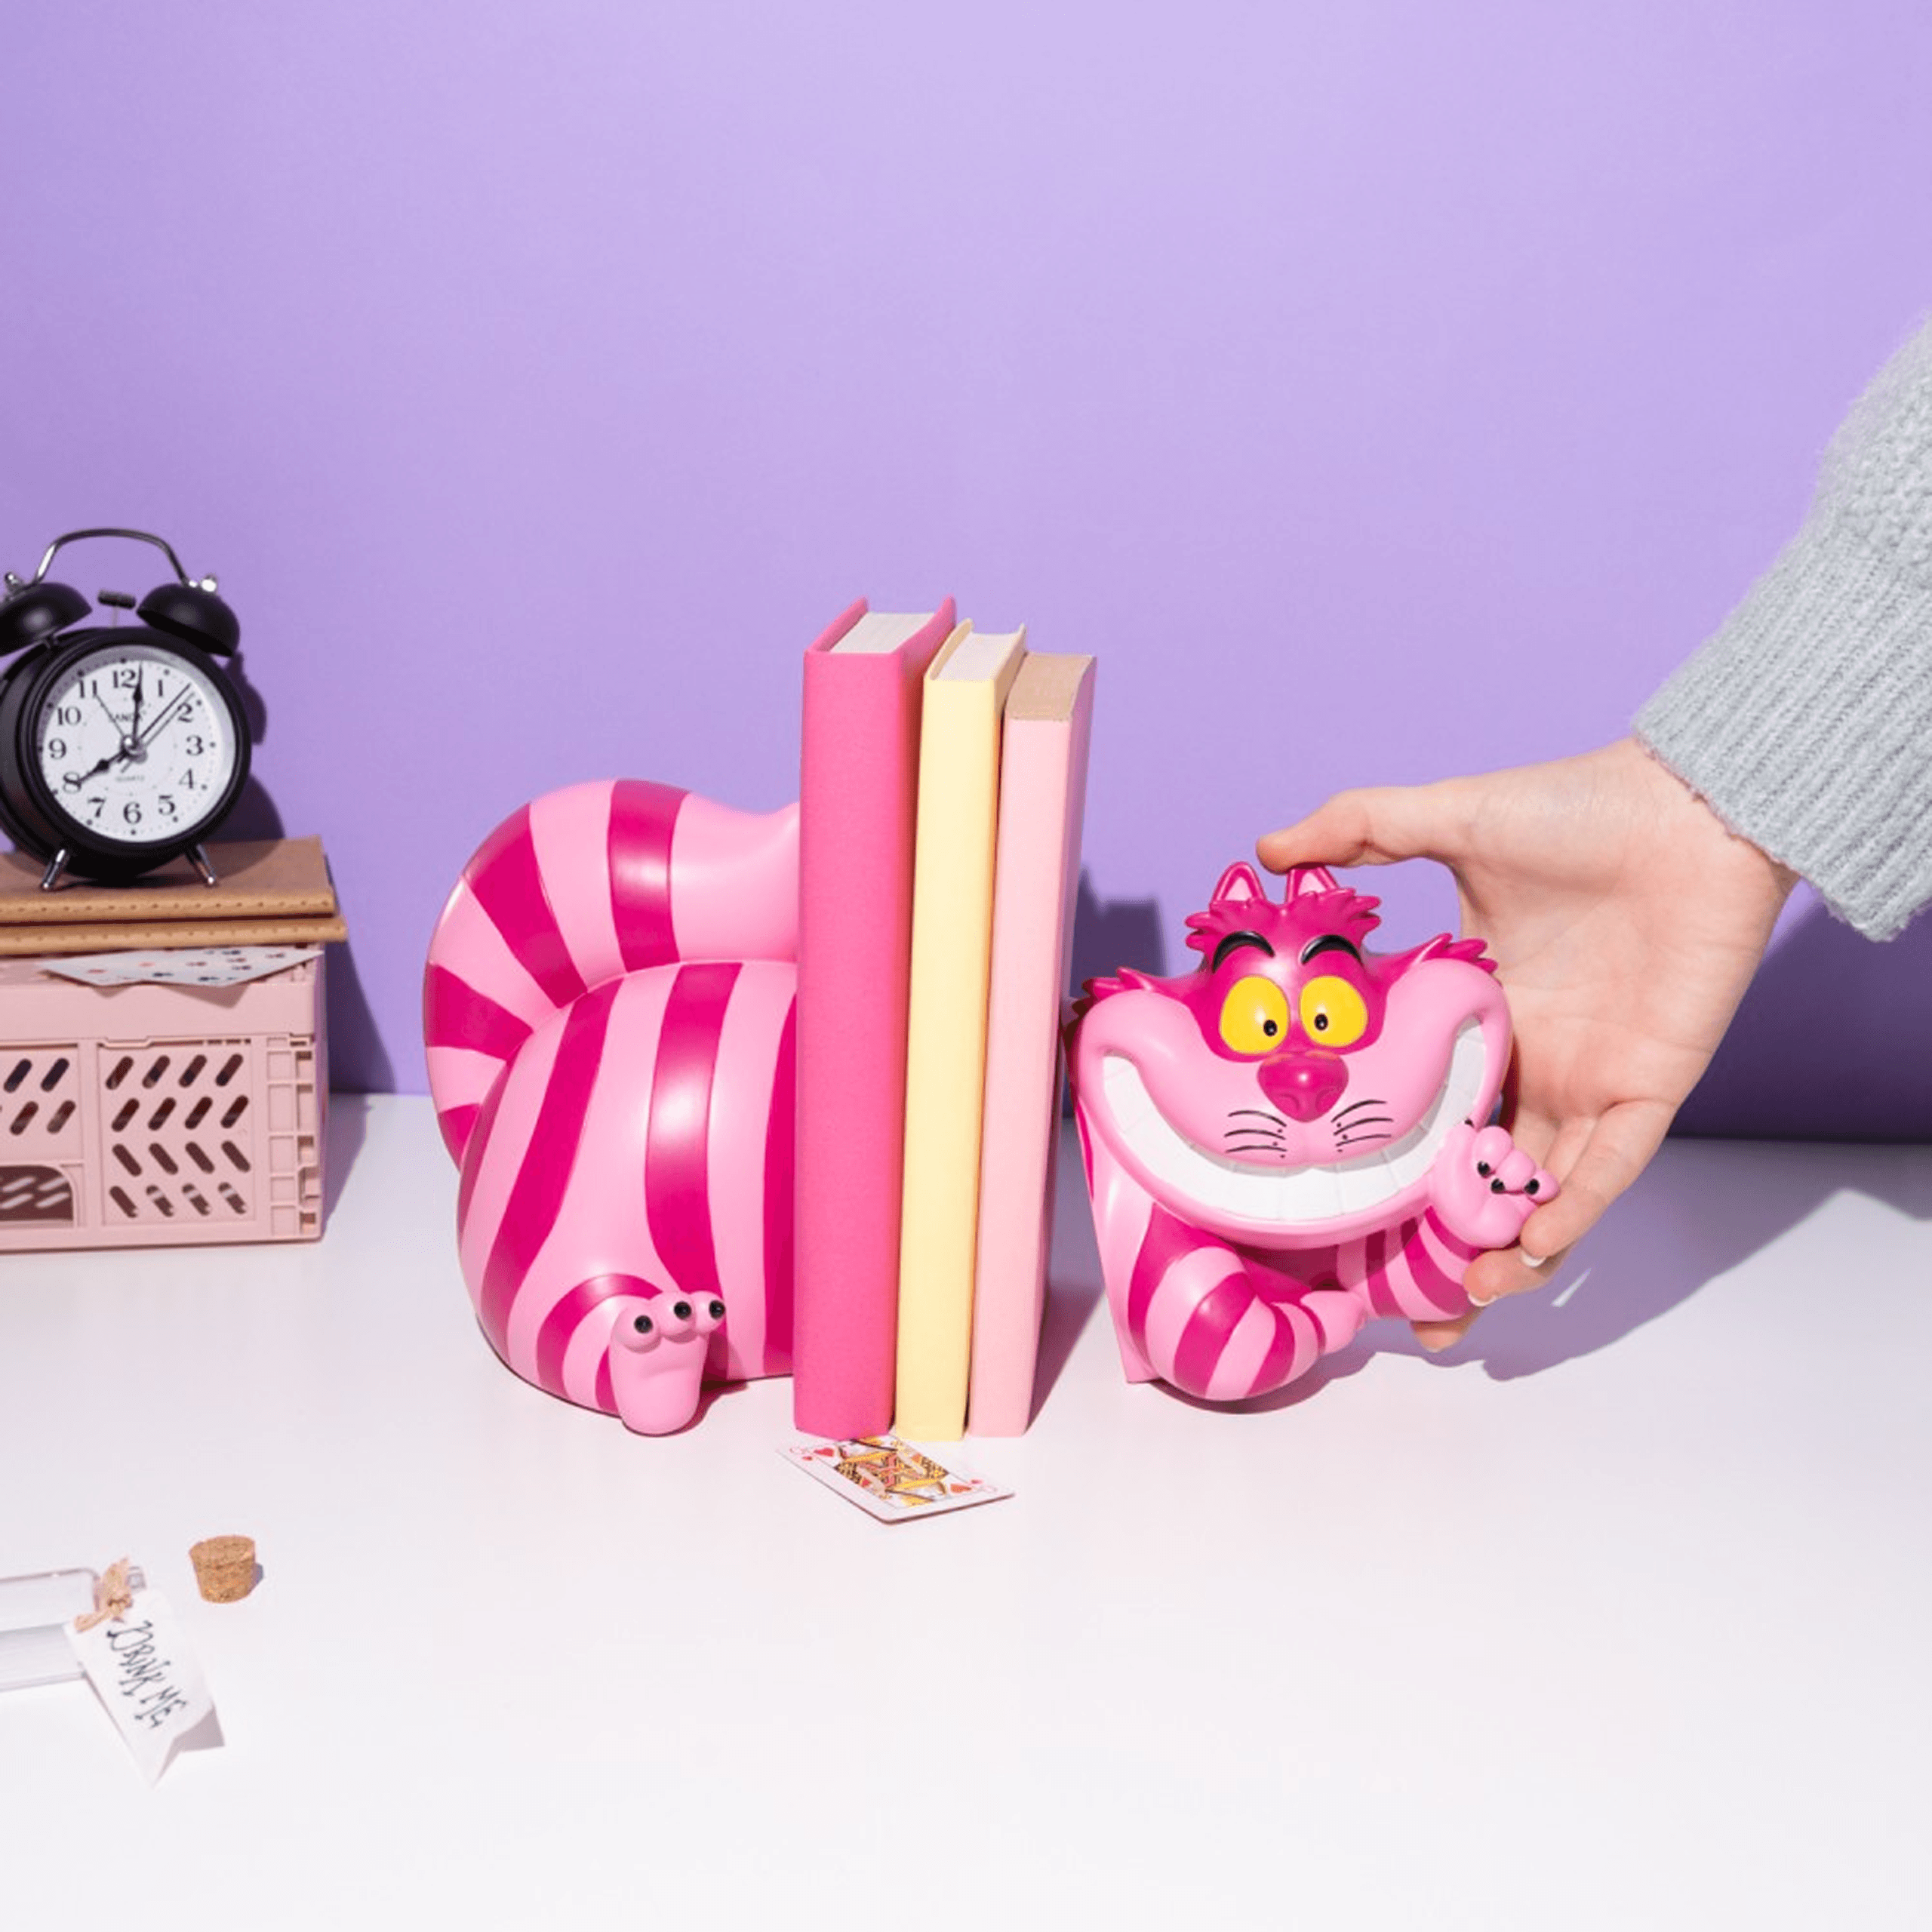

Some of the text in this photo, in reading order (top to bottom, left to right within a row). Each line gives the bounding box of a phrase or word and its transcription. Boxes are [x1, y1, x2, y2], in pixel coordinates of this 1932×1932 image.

[78, 679, 97, 698] 11
[112, 669, 137, 688] 12
[157, 679, 164, 697] 1
[57, 706, 82, 725] 10
[177, 703, 194, 722] 2
[48, 738, 66, 759] 9
[186, 735, 204, 755] 3
[63, 772, 82, 793] 8
[178, 768, 195, 789] 4
[88, 797, 106, 817] 7
[123, 802, 142, 824] 6
[158, 795, 176, 815] 5
[106, 1620, 188, 1728] DRINK ME
